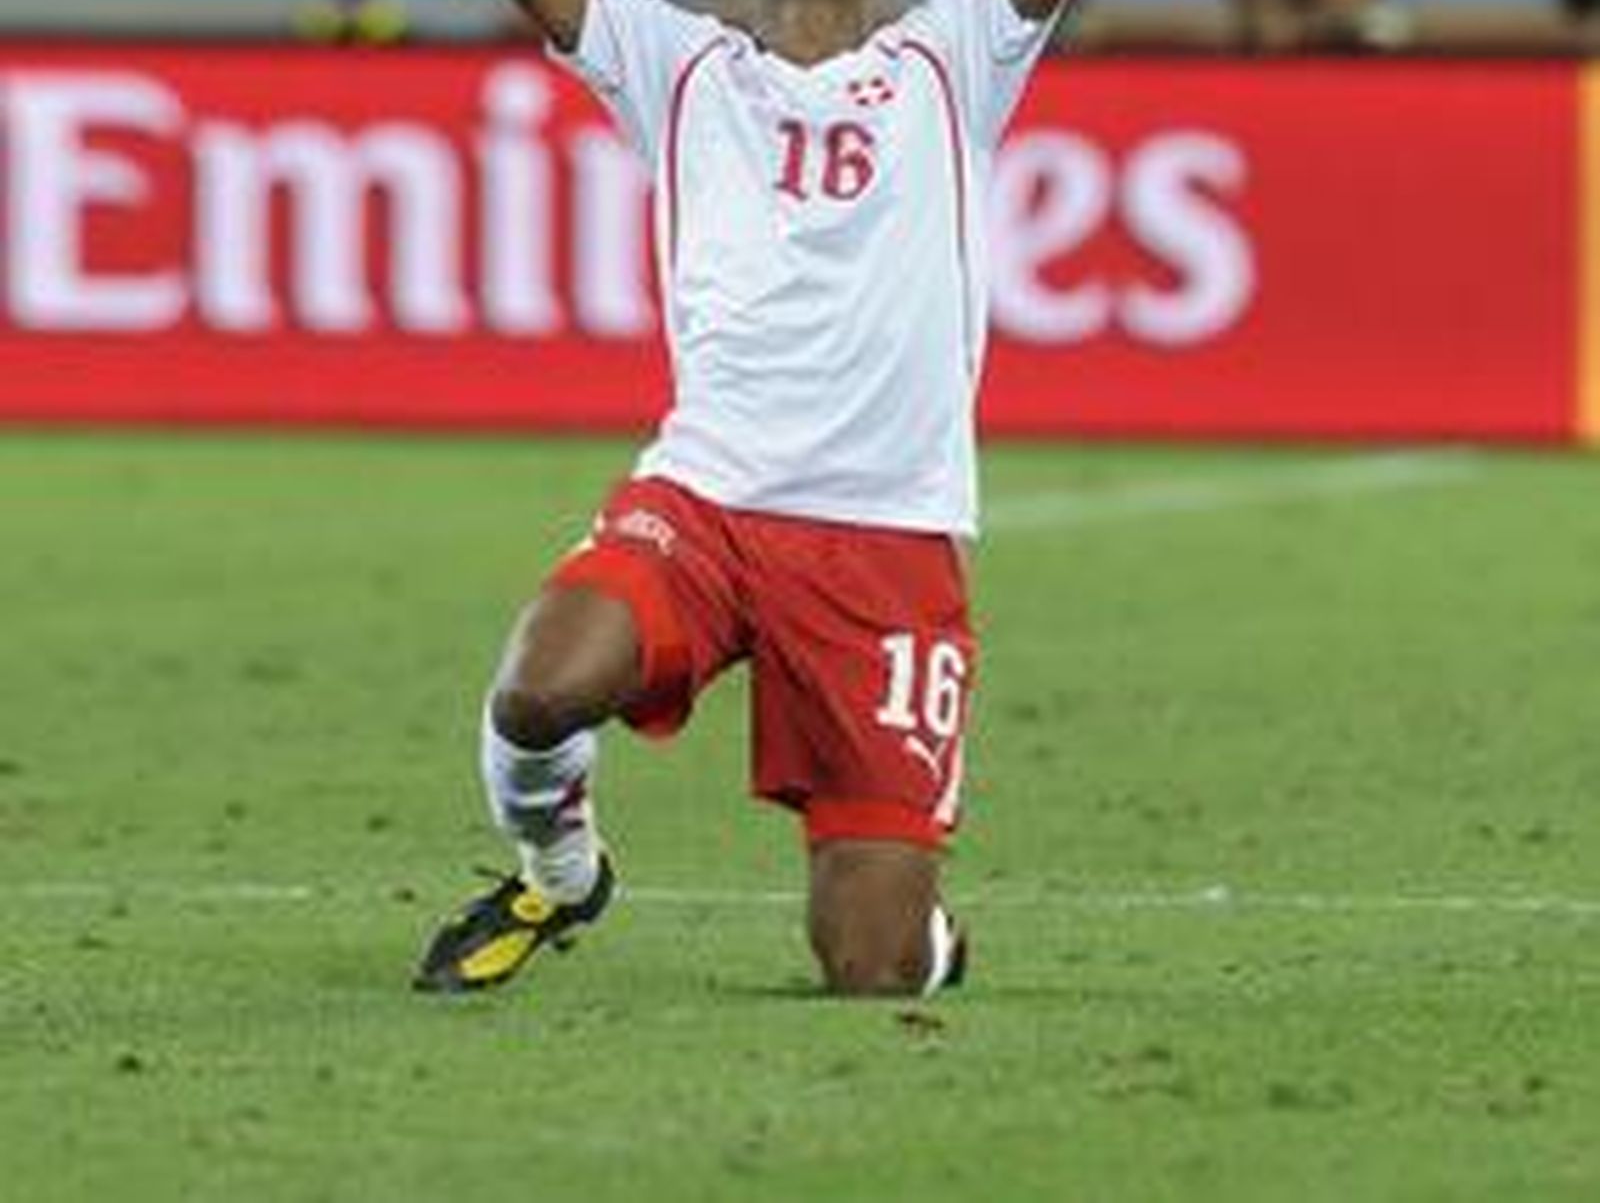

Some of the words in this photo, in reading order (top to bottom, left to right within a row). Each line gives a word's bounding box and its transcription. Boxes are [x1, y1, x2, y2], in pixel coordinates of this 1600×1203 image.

[3, 63, 1255, 346] Emires
[774, 119, 875, 200] 16
[876, 632, 965, 737] 16
